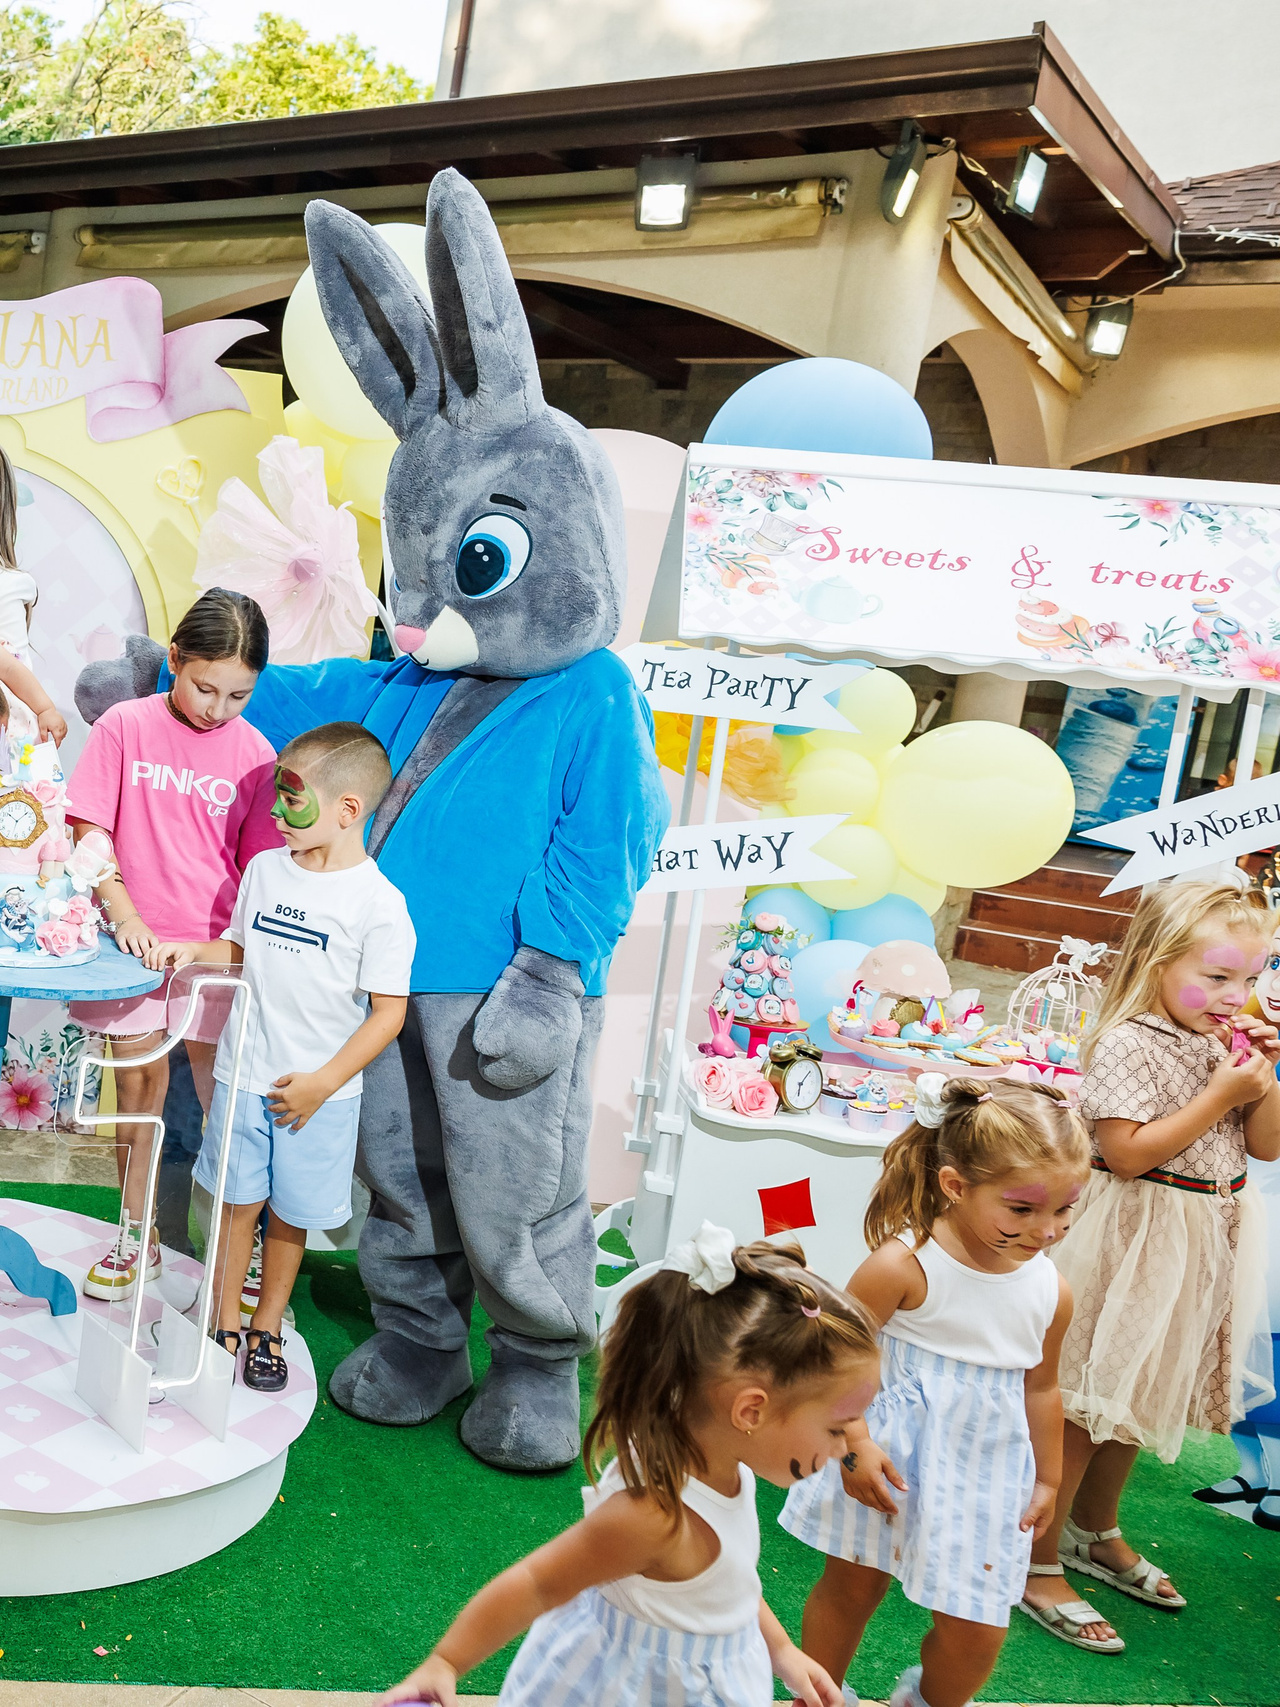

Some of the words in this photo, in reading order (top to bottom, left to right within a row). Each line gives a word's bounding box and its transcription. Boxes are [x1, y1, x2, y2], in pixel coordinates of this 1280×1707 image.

[795, 525, 972, 573] Sweets
[1011, 545, 1052, 589] &
[1089, 561, 1235, 594] treats
[131, 760, 238, 808] PINKO
[207, 804, 229, 818] UP
[275, 904, 306, 922] BOSS
